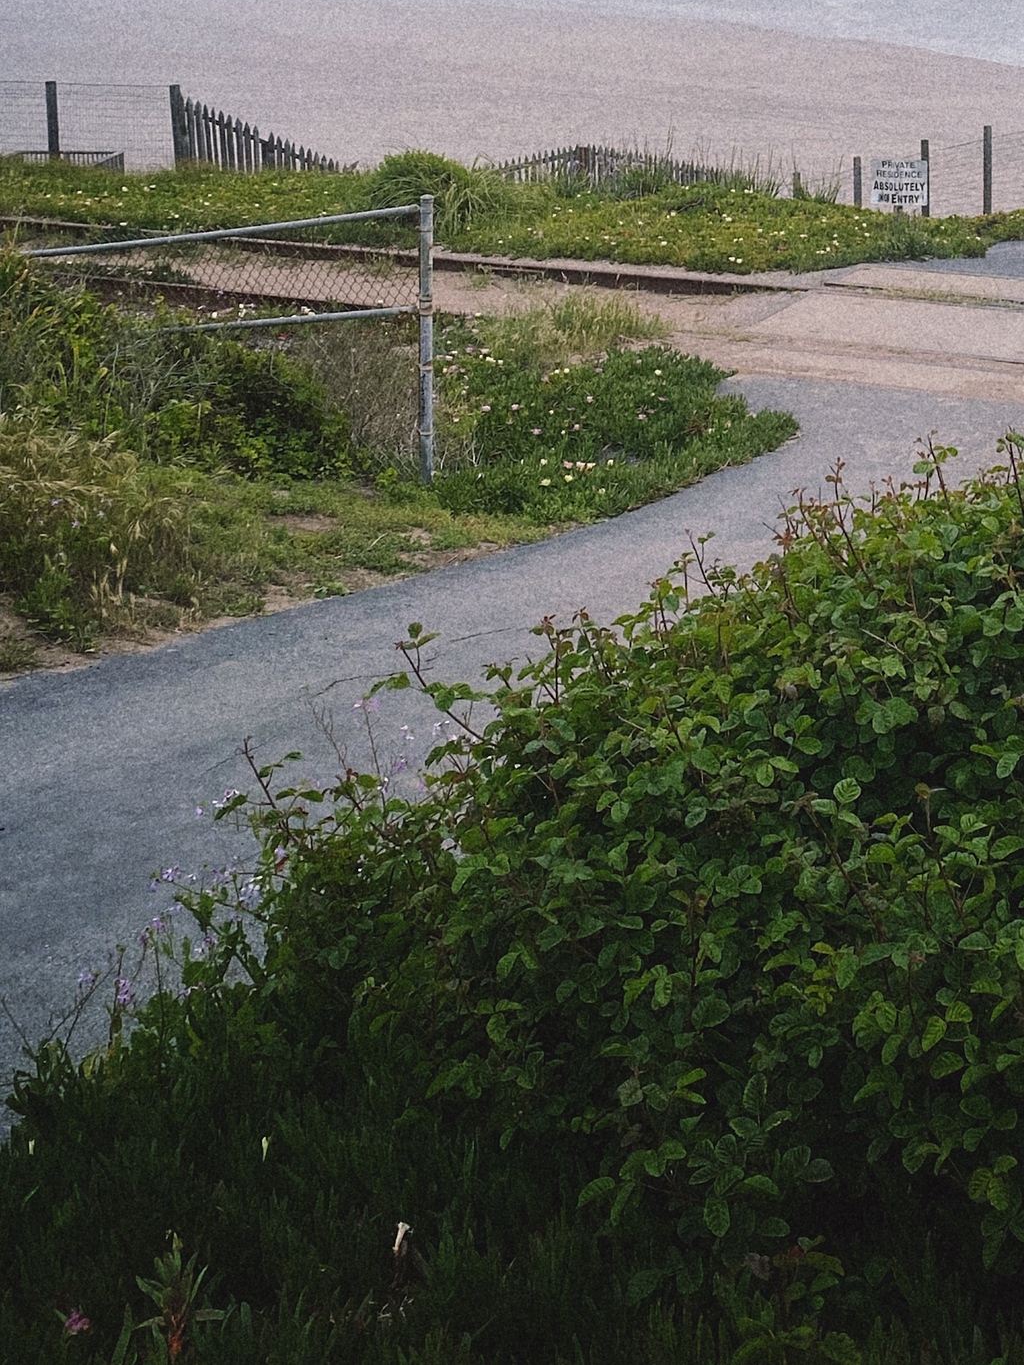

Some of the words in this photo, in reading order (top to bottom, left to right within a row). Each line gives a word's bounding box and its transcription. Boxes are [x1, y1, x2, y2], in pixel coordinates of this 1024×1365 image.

[881, 160, 916, 169] PRIVATE
[876, 169, 923, 178] RESIDENCE
[873, 180, 925, 191] ABSOLUTELY
[891, 193, 920, 204] ENTRY
